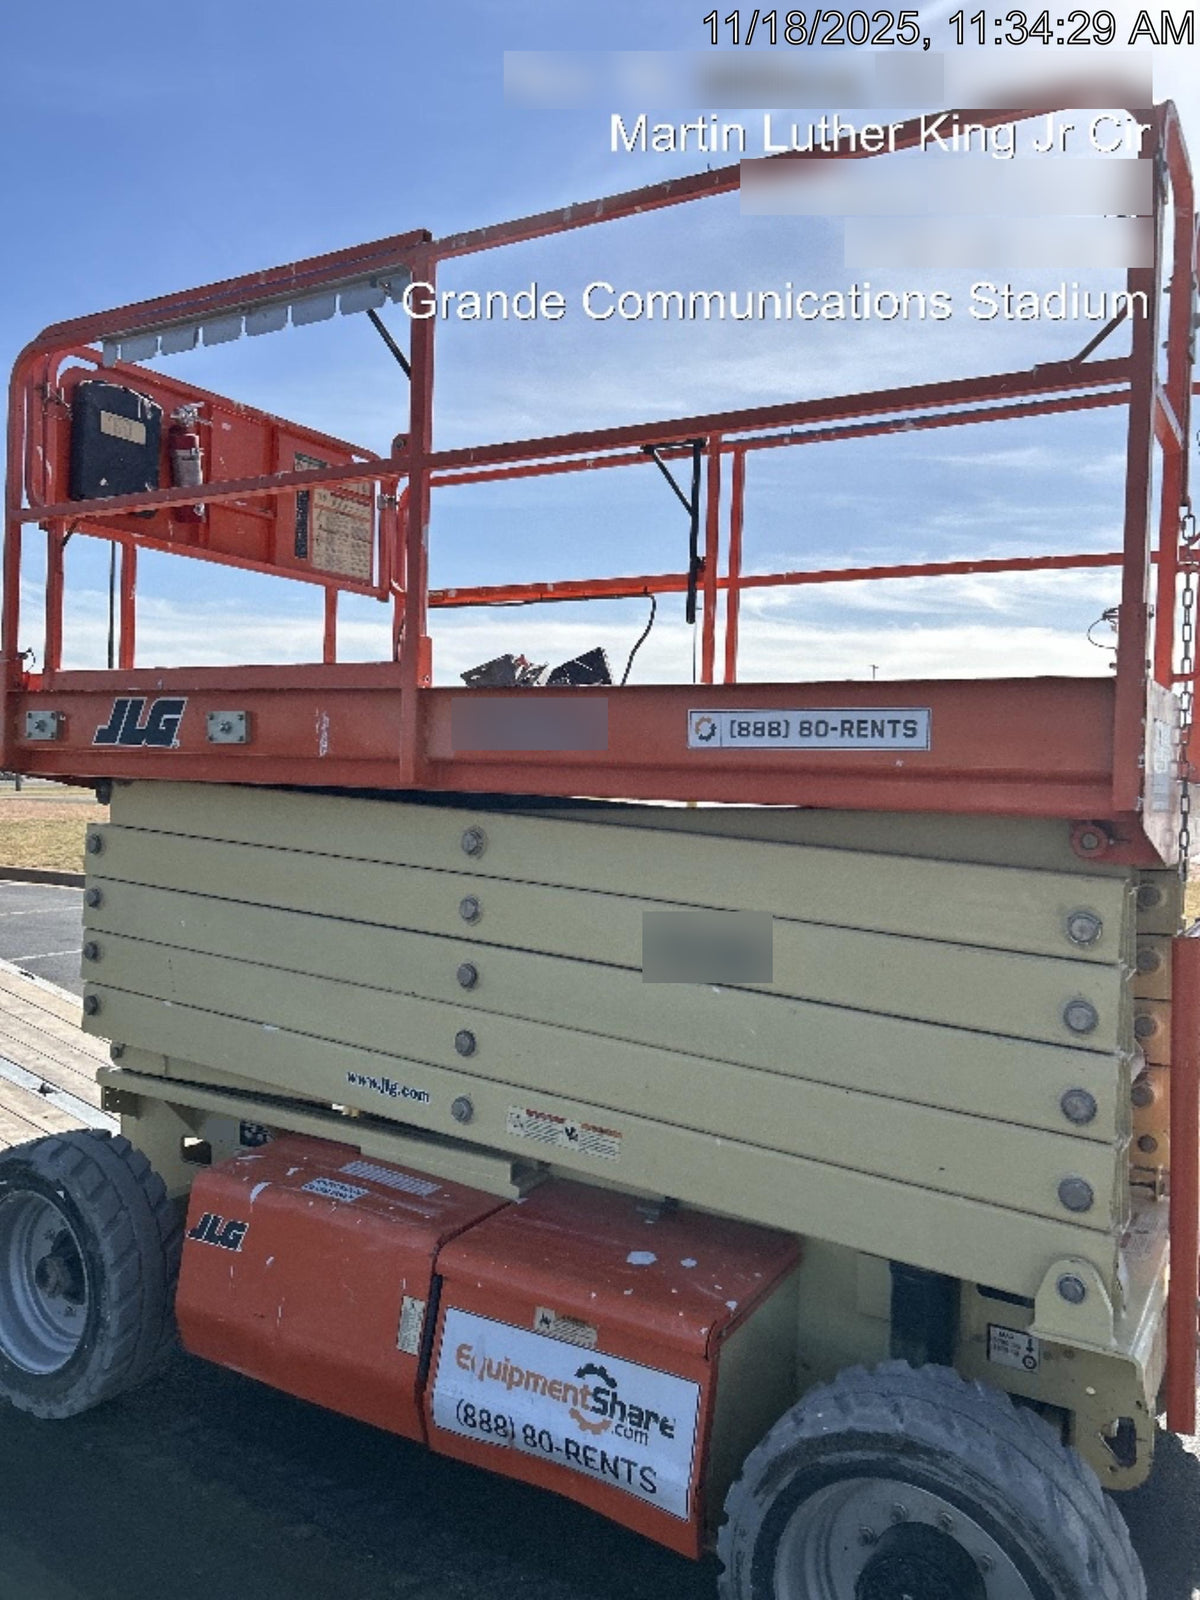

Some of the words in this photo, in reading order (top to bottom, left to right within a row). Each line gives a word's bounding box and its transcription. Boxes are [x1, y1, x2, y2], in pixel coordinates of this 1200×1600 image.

[92, 697, 188, 748] JLG
[798, 719, 918, 738] 80-RENTS
[347, 1071, 430, 1104] www.jlg.com
[186, 1211, 250, 1252] JLG
[456, 1398, 516, 1441] (888)
[521, 1423, 657, 1494] 80-RENTS
[610, 1423, 649, 1446] .com
